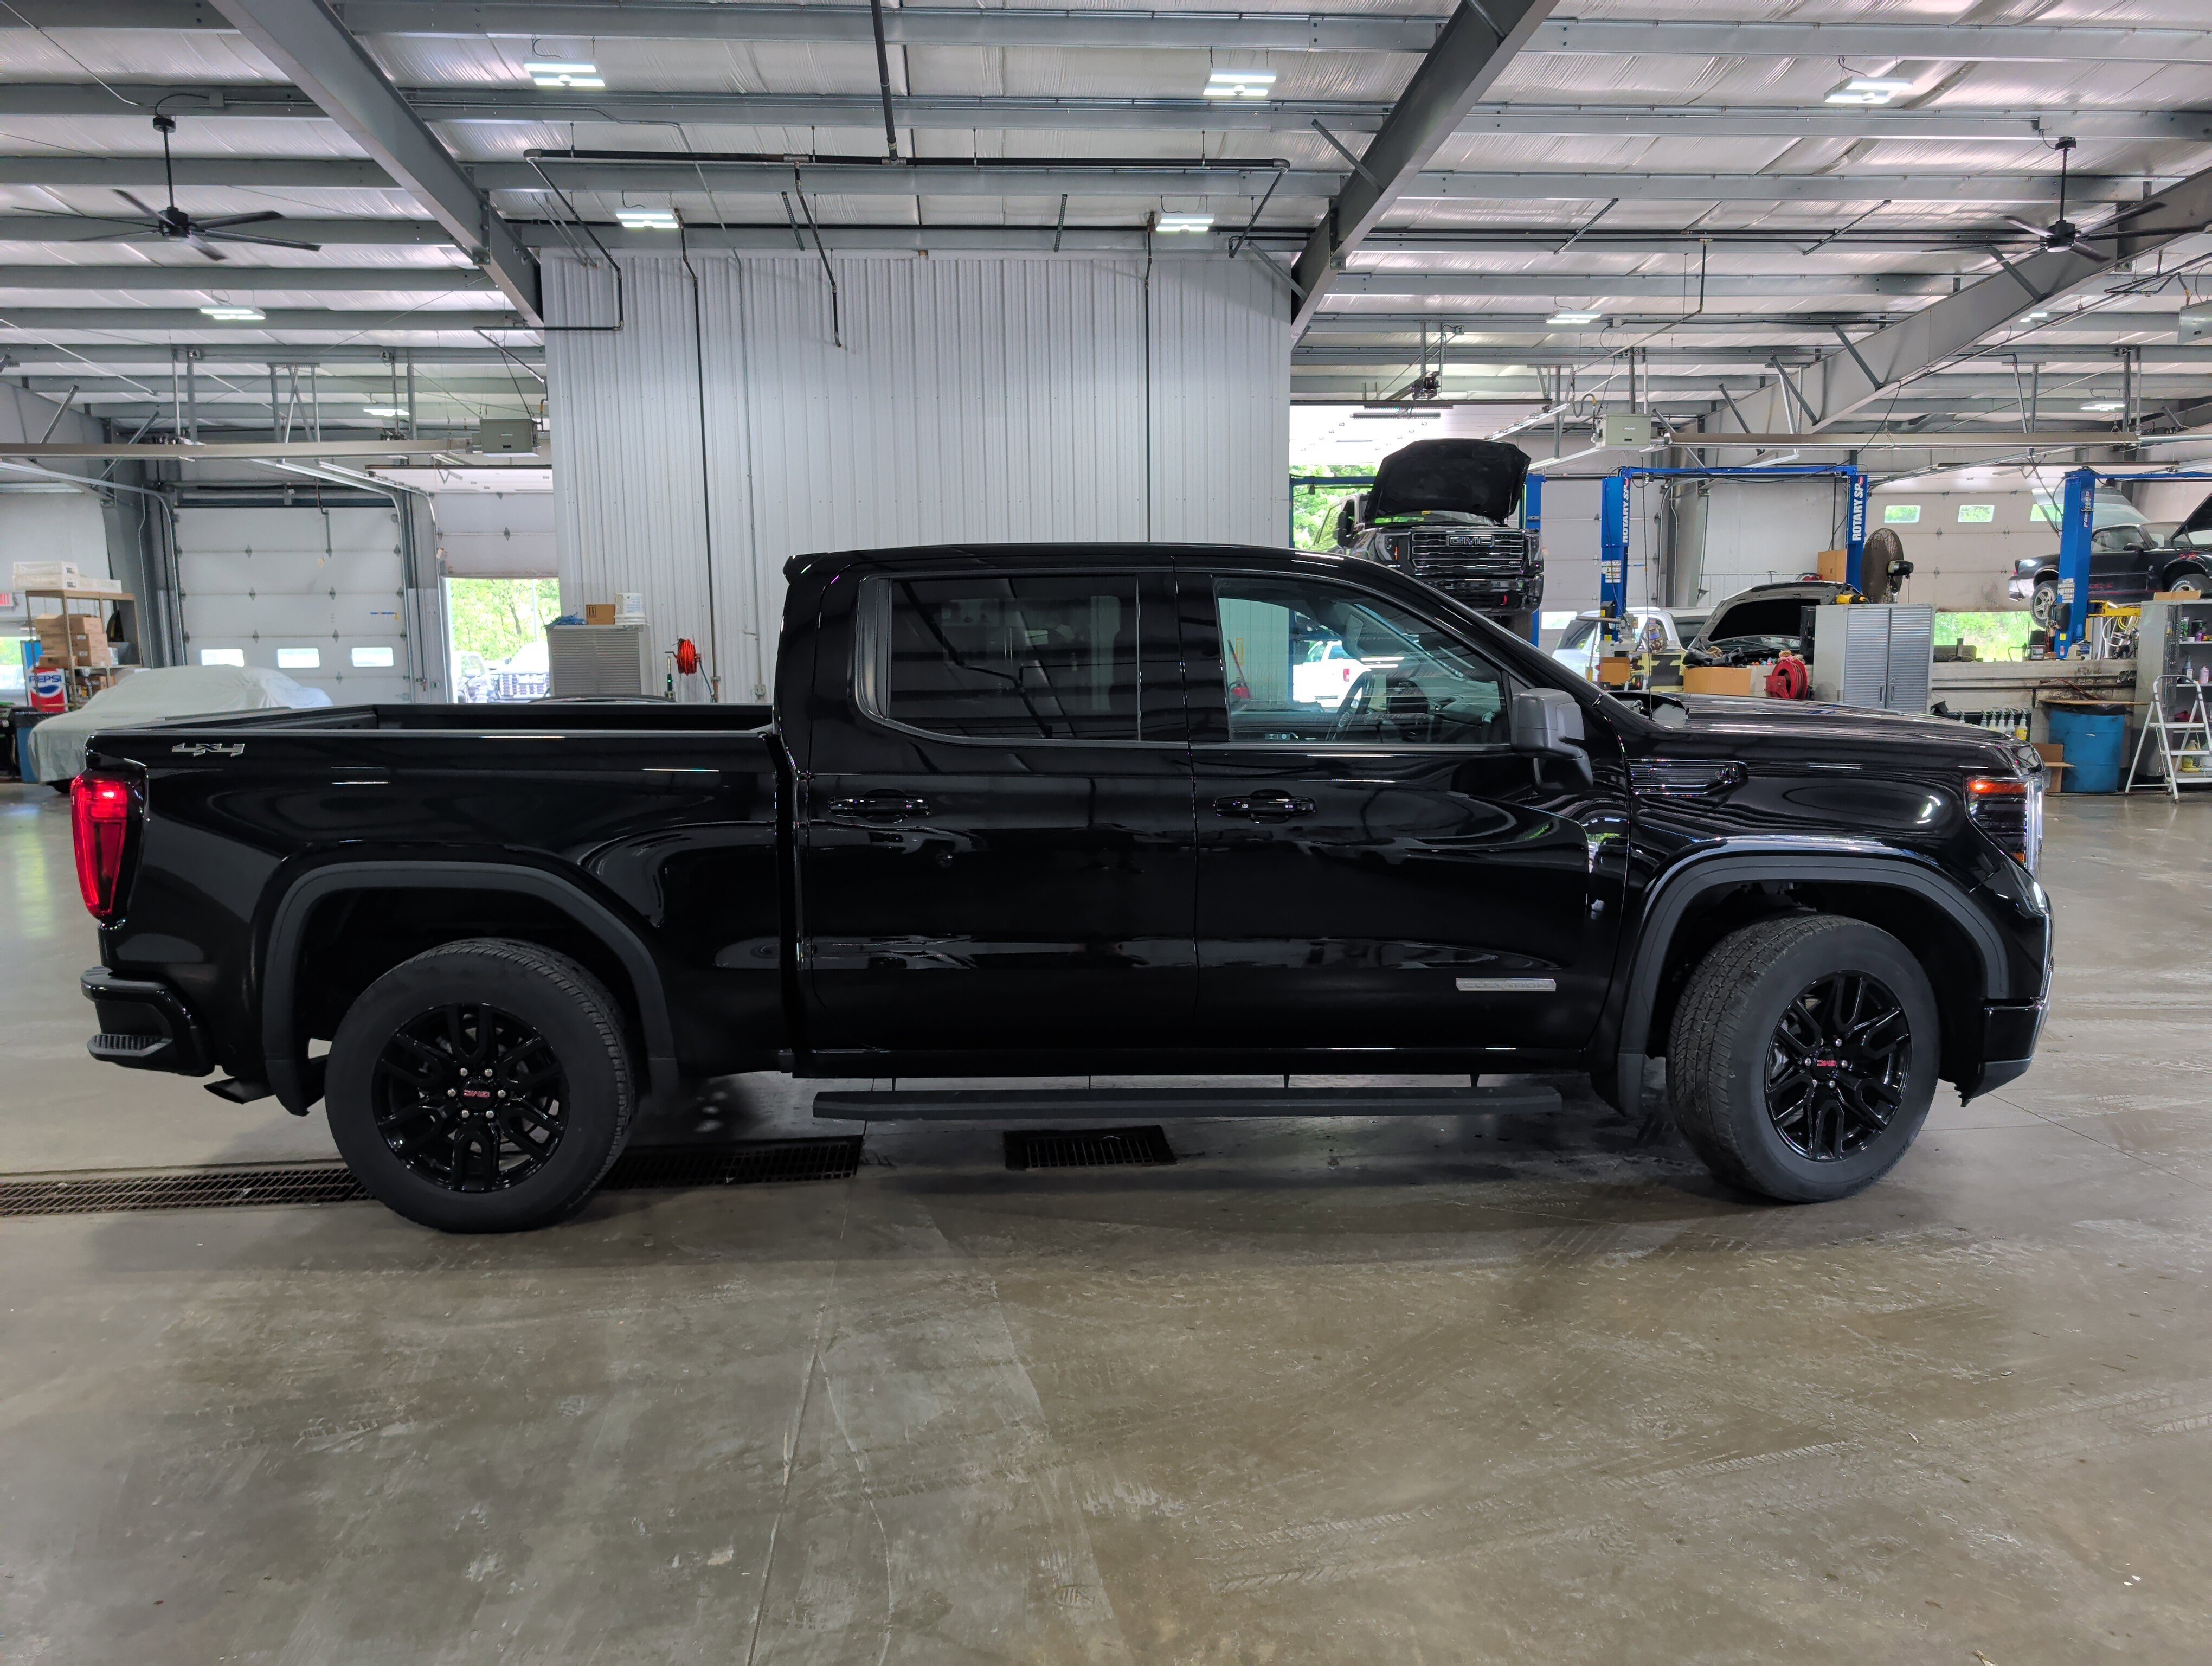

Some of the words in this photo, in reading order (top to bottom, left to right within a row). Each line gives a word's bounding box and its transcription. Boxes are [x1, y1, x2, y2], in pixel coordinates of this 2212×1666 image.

[1623, 484, 1629, 500] SP
[1854, 483, 1863, 498] SP
[1852, 499, 1863, 541] ROTARY
[1449, 536, 1492, 546] GMC
[29, 675, 62, 683] PEPSI
[1464, 980, 1549, 988] ELEVATION
[1816, 1059, 1837, 1067] GMC
[463, 1088, 490, 1098] GMC
